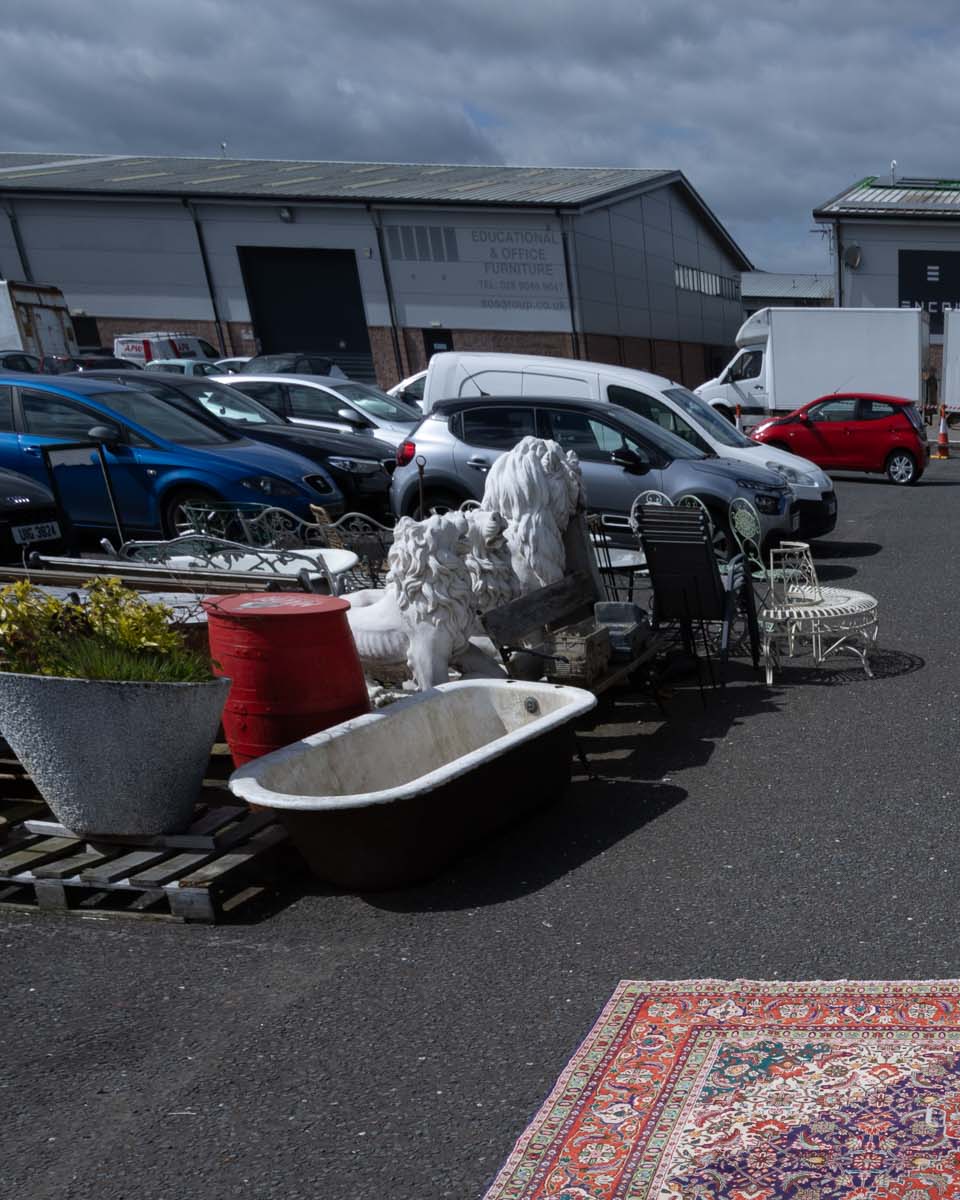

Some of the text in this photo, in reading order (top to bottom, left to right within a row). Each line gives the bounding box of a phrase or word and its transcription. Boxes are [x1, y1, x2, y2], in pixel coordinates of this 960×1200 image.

[471, 230, 559, 244] EDUCATIONAL
[489, 247, 546, 261] & OFFICE
[483, 262, 553, 276] FURNITURE
